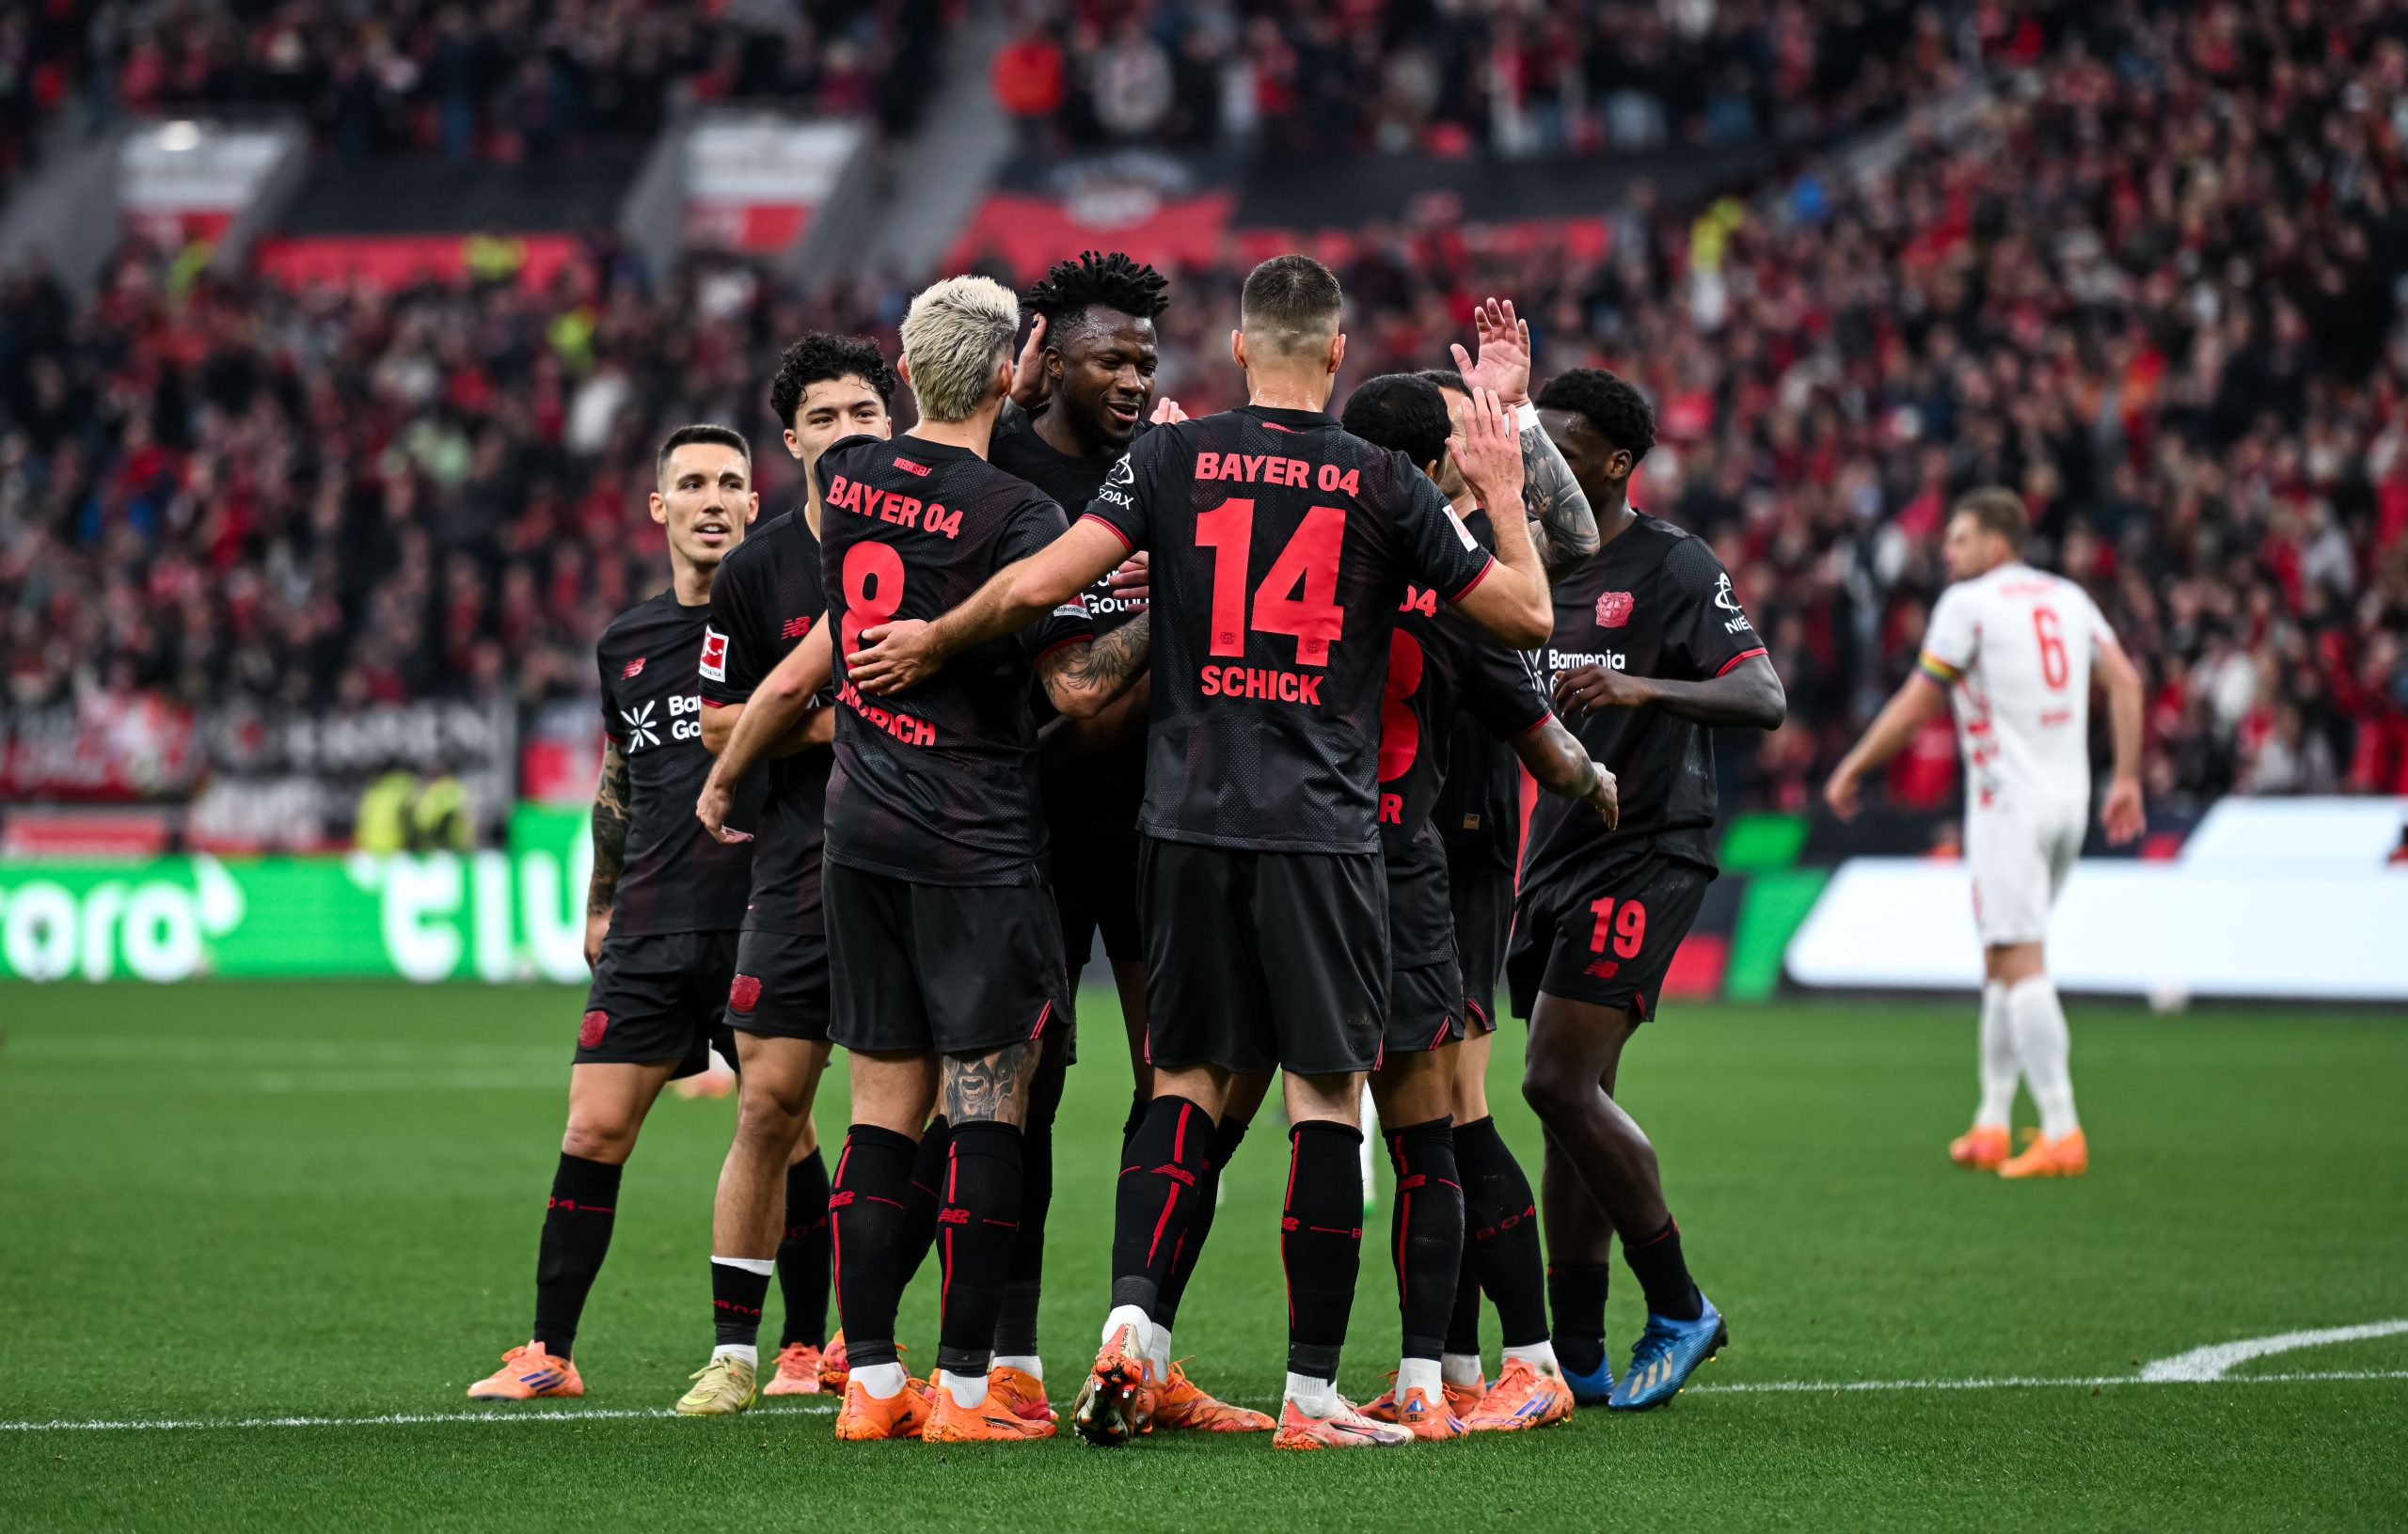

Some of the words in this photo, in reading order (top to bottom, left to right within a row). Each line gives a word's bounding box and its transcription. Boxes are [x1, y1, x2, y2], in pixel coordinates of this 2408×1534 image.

[825, 474, 922, 528] BAYER
[923, 502, 964, 540] 04
[1195, 451, 1310, 488] BAYER
[1317, 464, 1360, 498] 04
[1195, 497, 1346, 667] 14
[842, 540, 905, 694] 8
[2033, 605, 2070, 689] 6
[1201, 665, 1324, 705] SCHICK
[1590, 896, 1646, 959] 19
